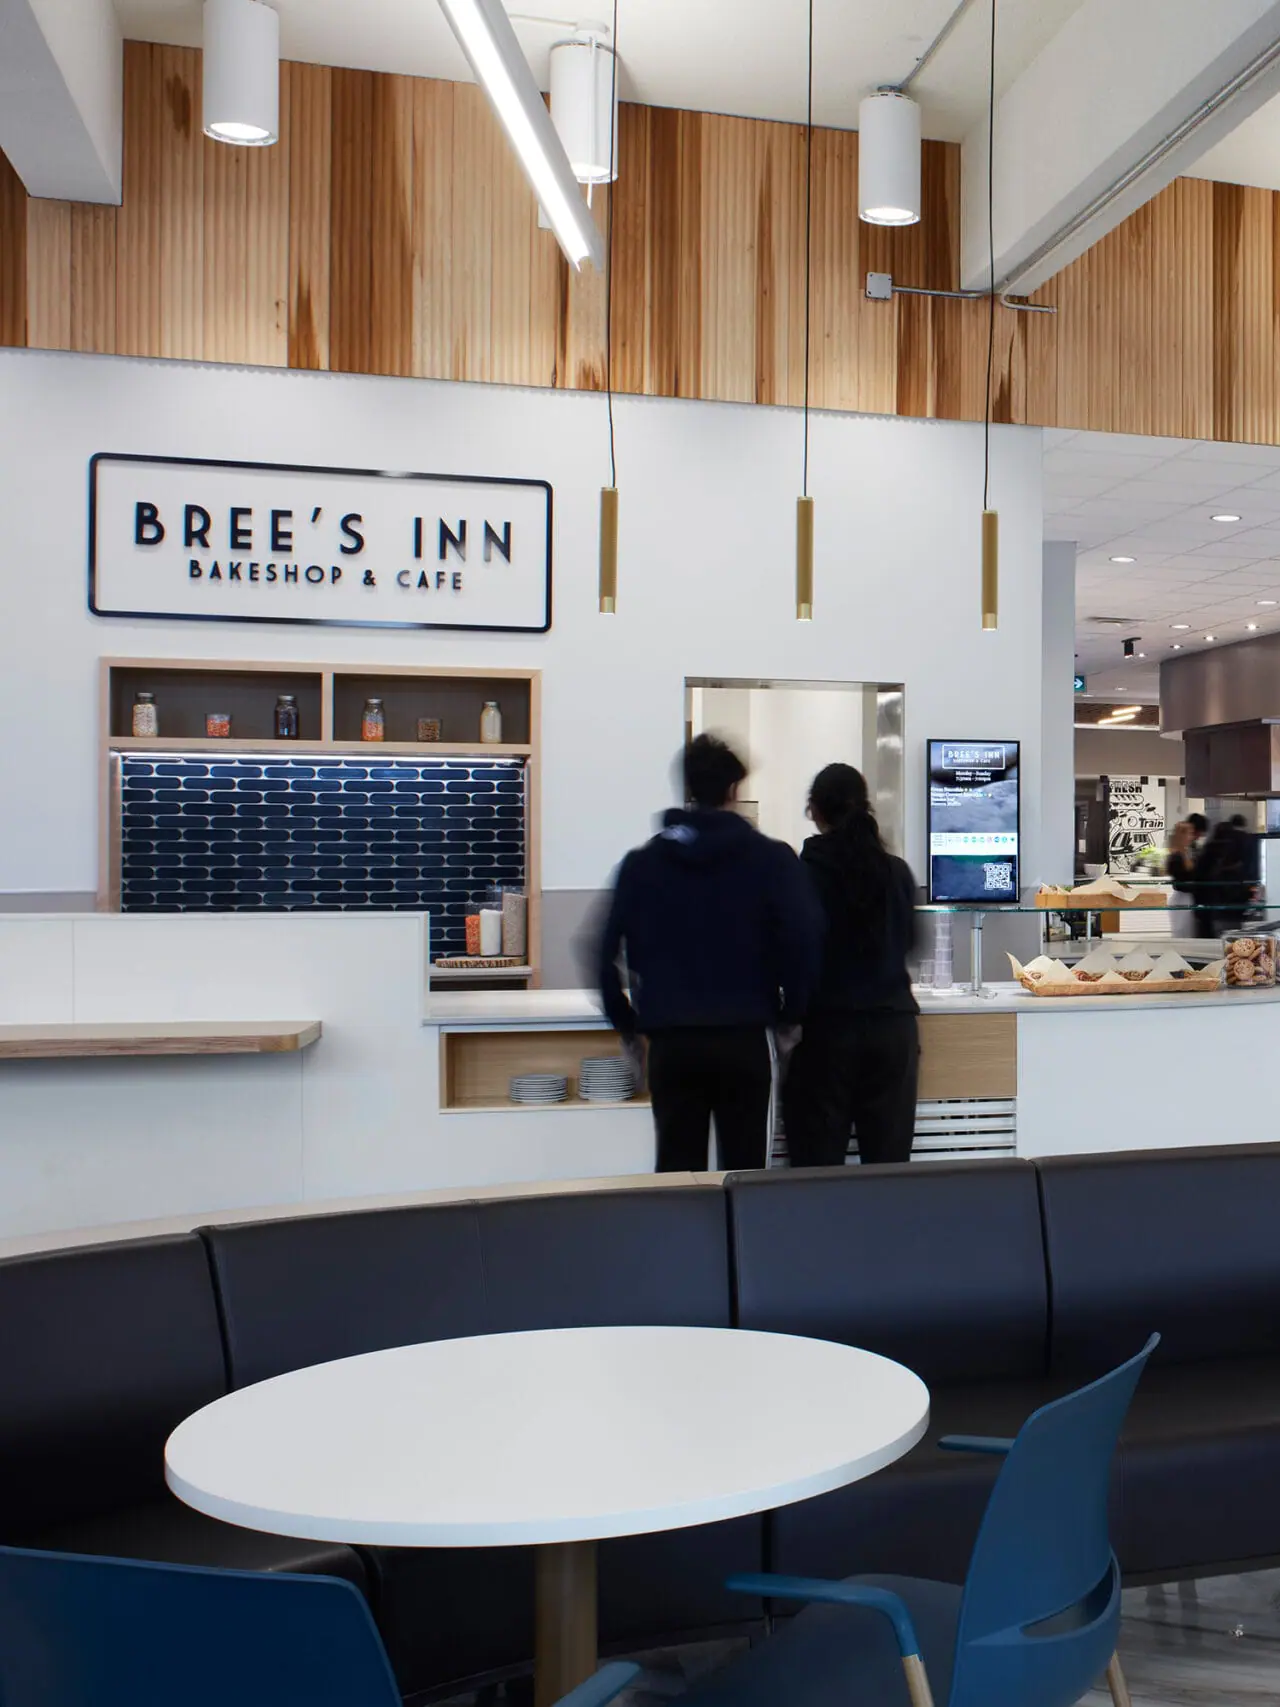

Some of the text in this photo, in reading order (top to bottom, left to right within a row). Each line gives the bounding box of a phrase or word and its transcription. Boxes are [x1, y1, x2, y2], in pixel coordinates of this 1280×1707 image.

[135, 501, 511, 563] BREE'S INN
[189, 559, 462, 590] BAKESHOP & CAFE
[1139, 818, 1164, 828] Train
